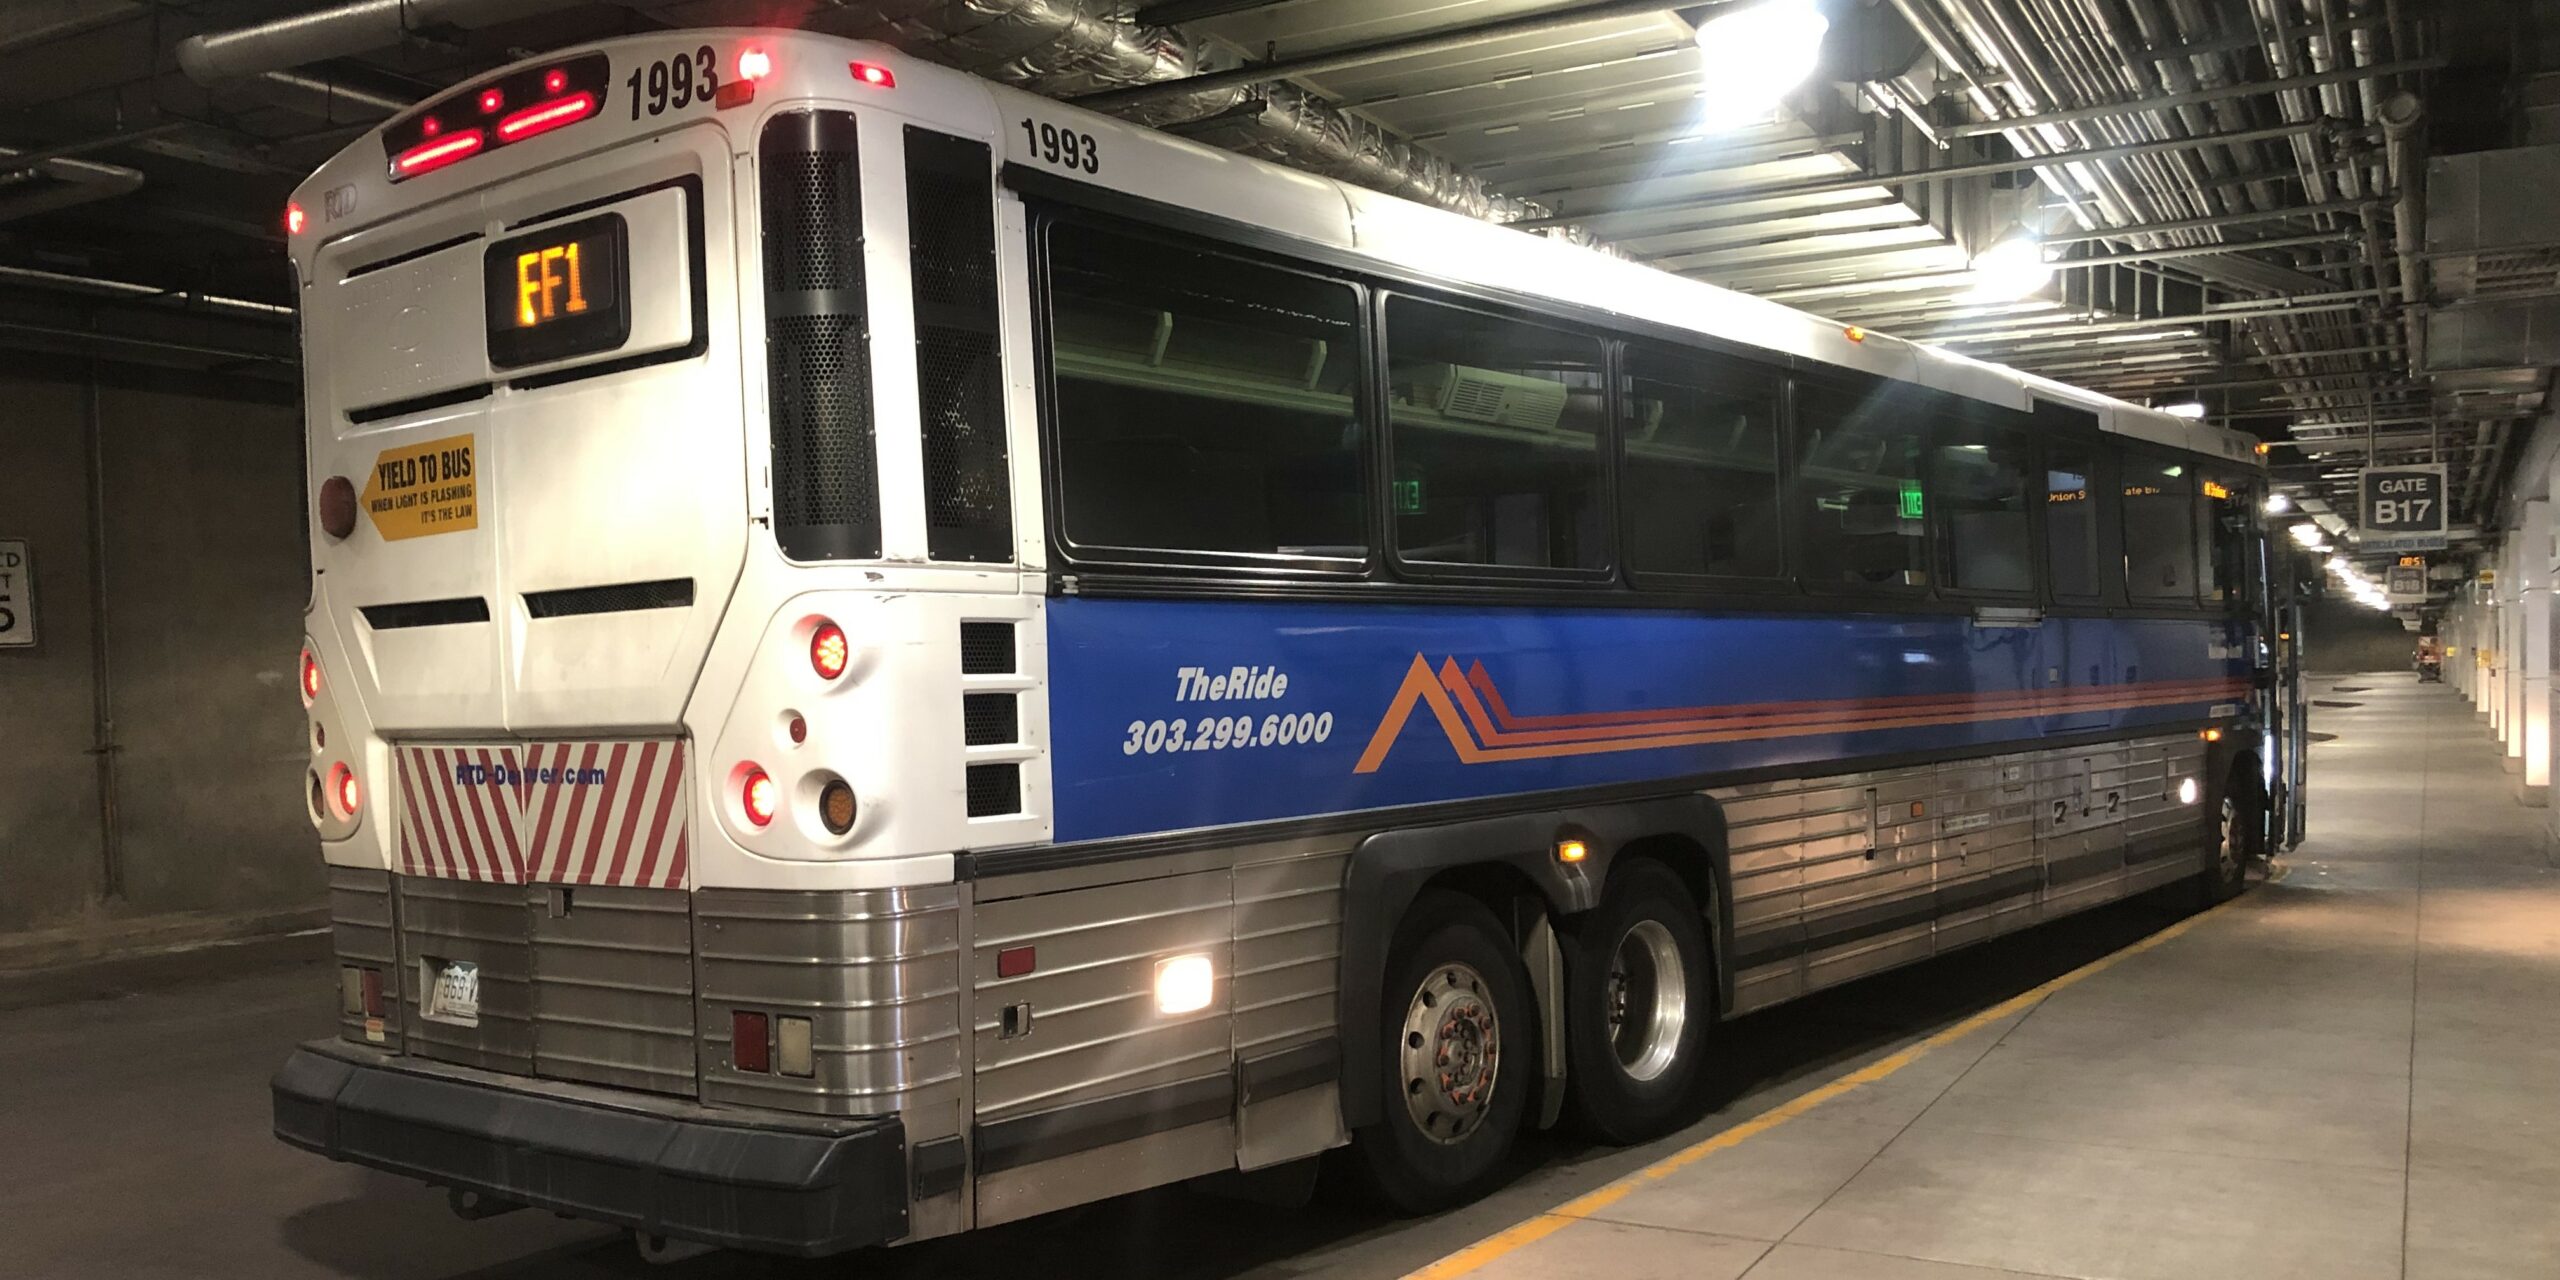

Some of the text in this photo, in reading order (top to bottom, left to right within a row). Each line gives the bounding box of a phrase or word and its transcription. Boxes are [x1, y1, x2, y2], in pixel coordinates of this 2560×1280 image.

[627, 45, 718, 121] 1993
[1021, 117, 1099, 174] 1993
[517, 242, 587, 327] FF1
[378, 447, 471, 491] YIELD TO BUS
[2379, 478, 2427, 493] GATE
[371, 483, 472, 512] WHEN LIGHT IS FLASHING
[421, 504, 472, 524] IT'S THE LAW
[2375, 499, 2432, 524] B17
[1176, 665, 1288, 702] TheRide
[1123, 711, 1333, 755] 303.299.6000
[456, 764, 605, 785] RTD-Denver.com
